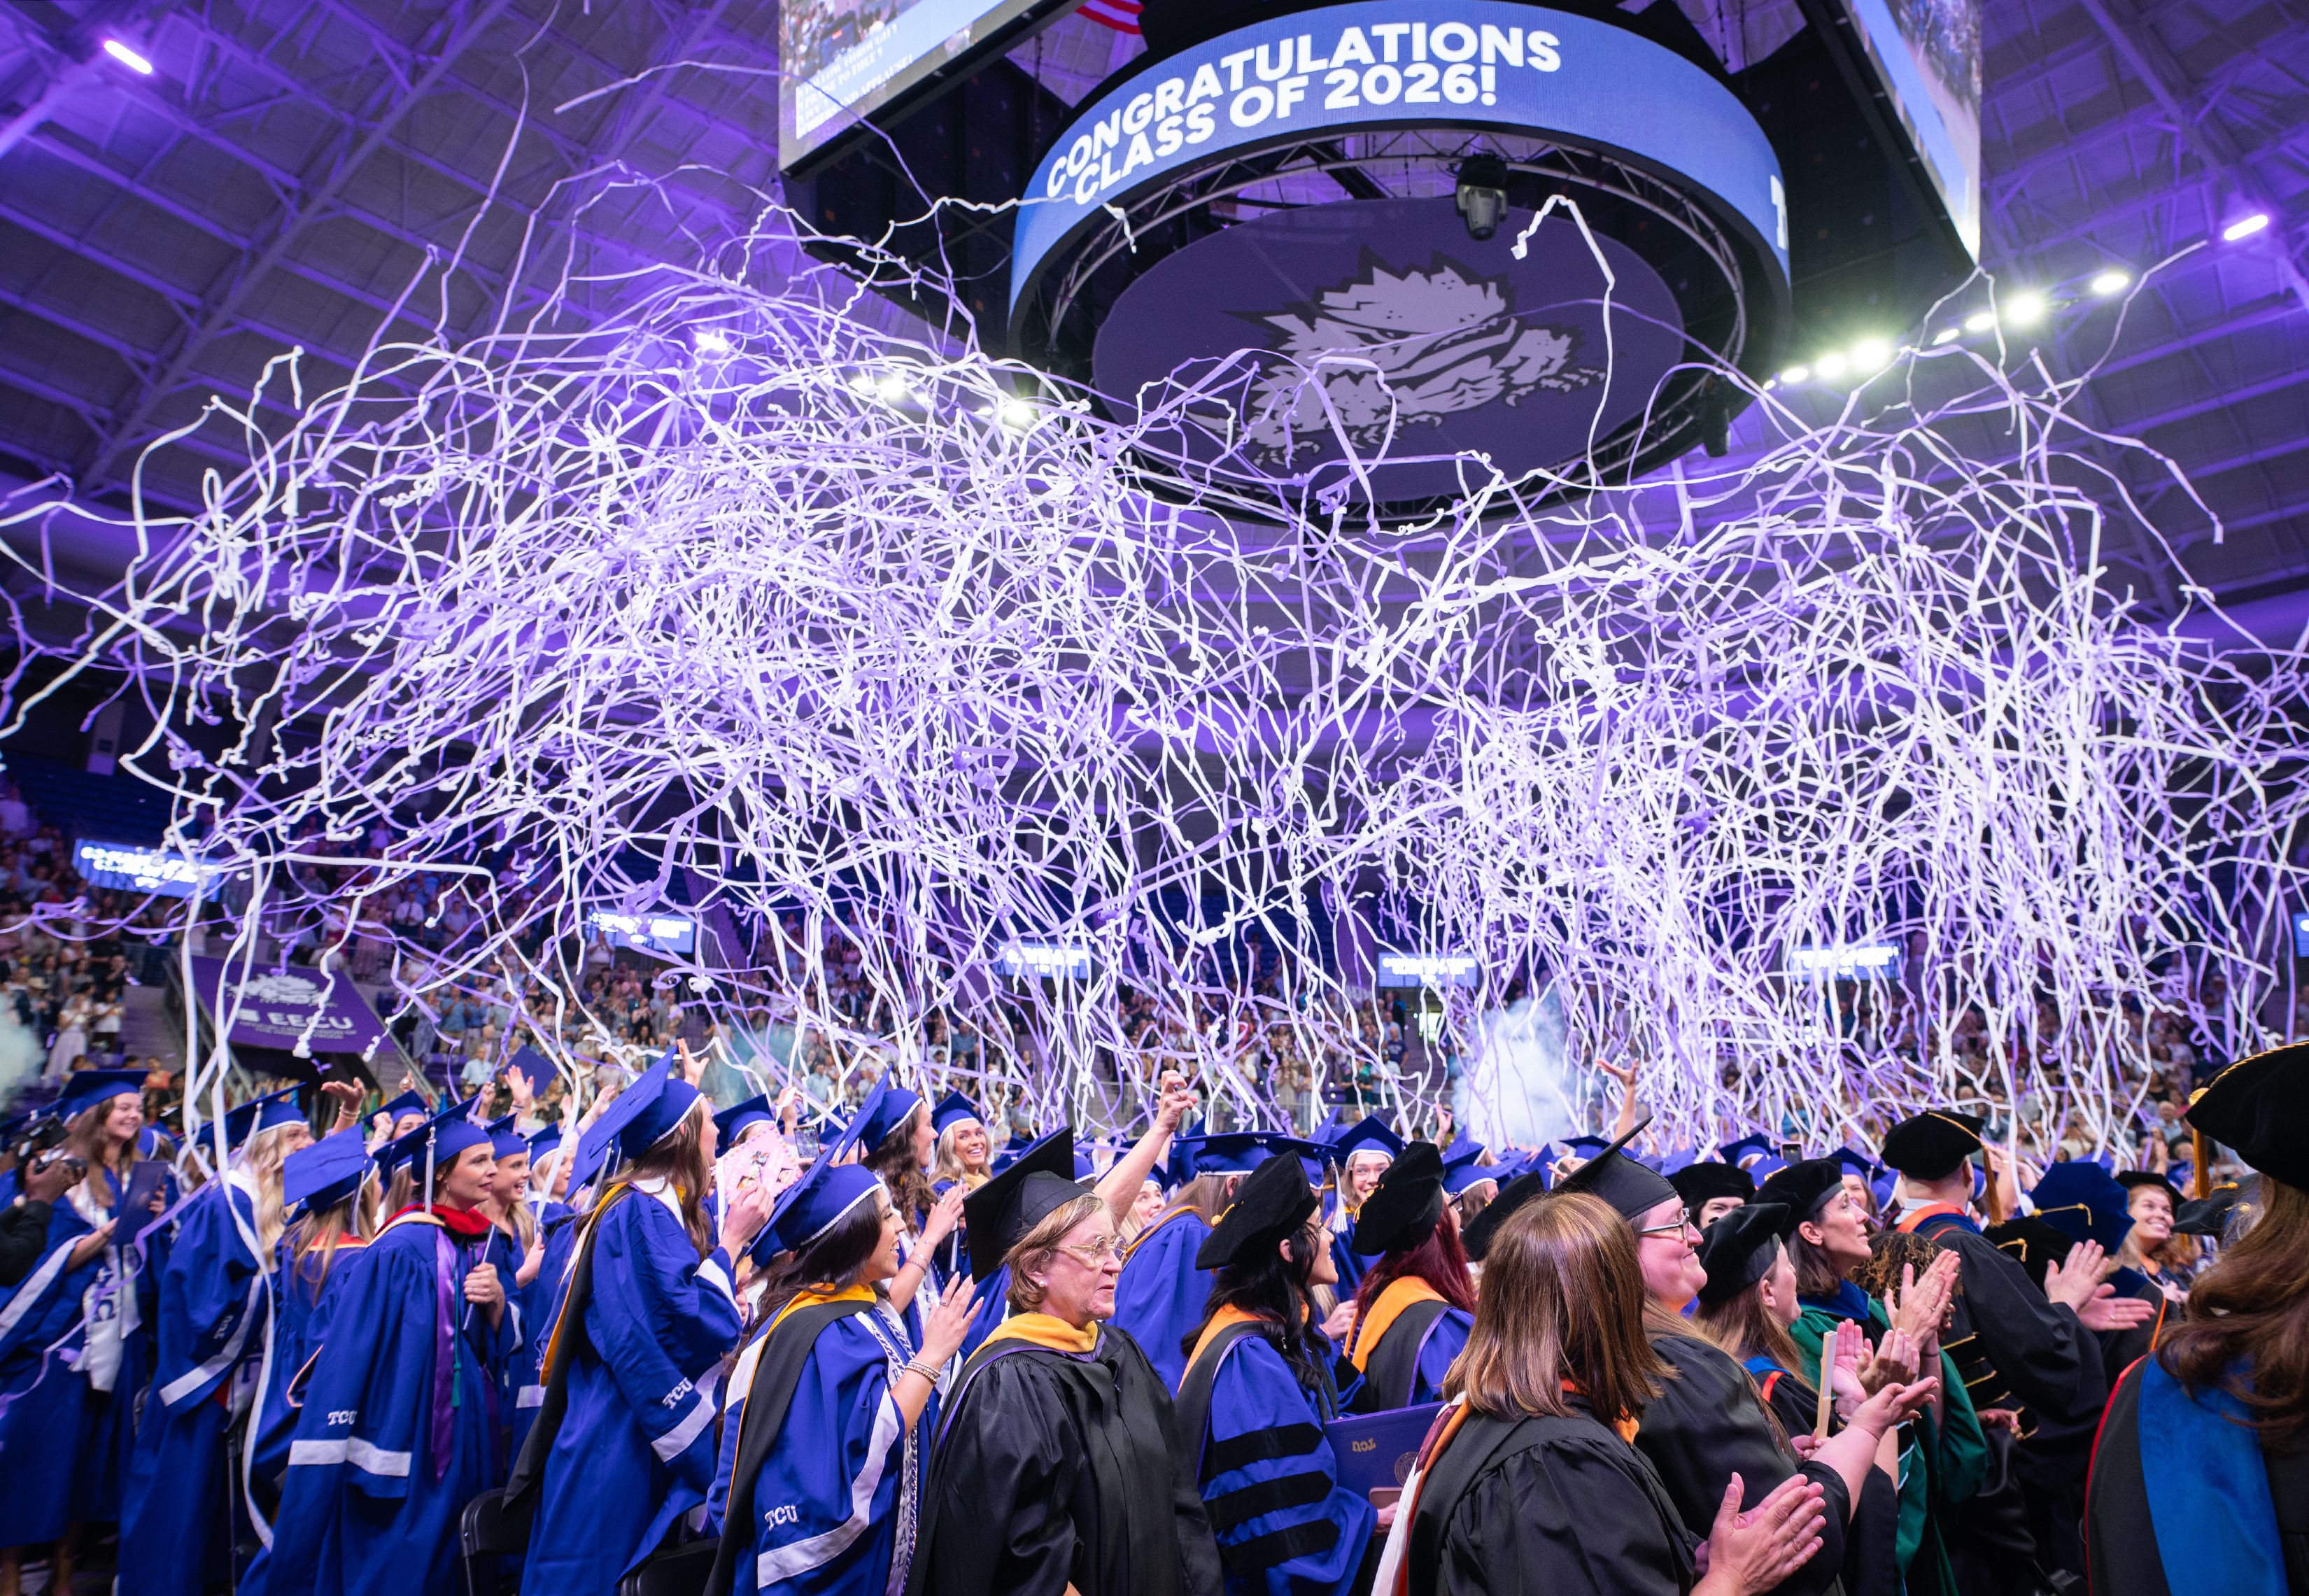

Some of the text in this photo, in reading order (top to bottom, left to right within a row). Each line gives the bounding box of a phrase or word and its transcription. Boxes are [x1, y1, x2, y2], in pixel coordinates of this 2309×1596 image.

[1047, 22, 1561, 197] CONGRATULATIONS
[1074, 62, 1497, 205] CLASS OF 2026!
[267, 1012, 354, 1030] EECU
[662, 1377, 694, 1411] TCU
[328, 1410, 358, 1426] TCU
[1352, 1438, 1376, 1452] TCU
[765, 1505, 798, 1532] TCU
